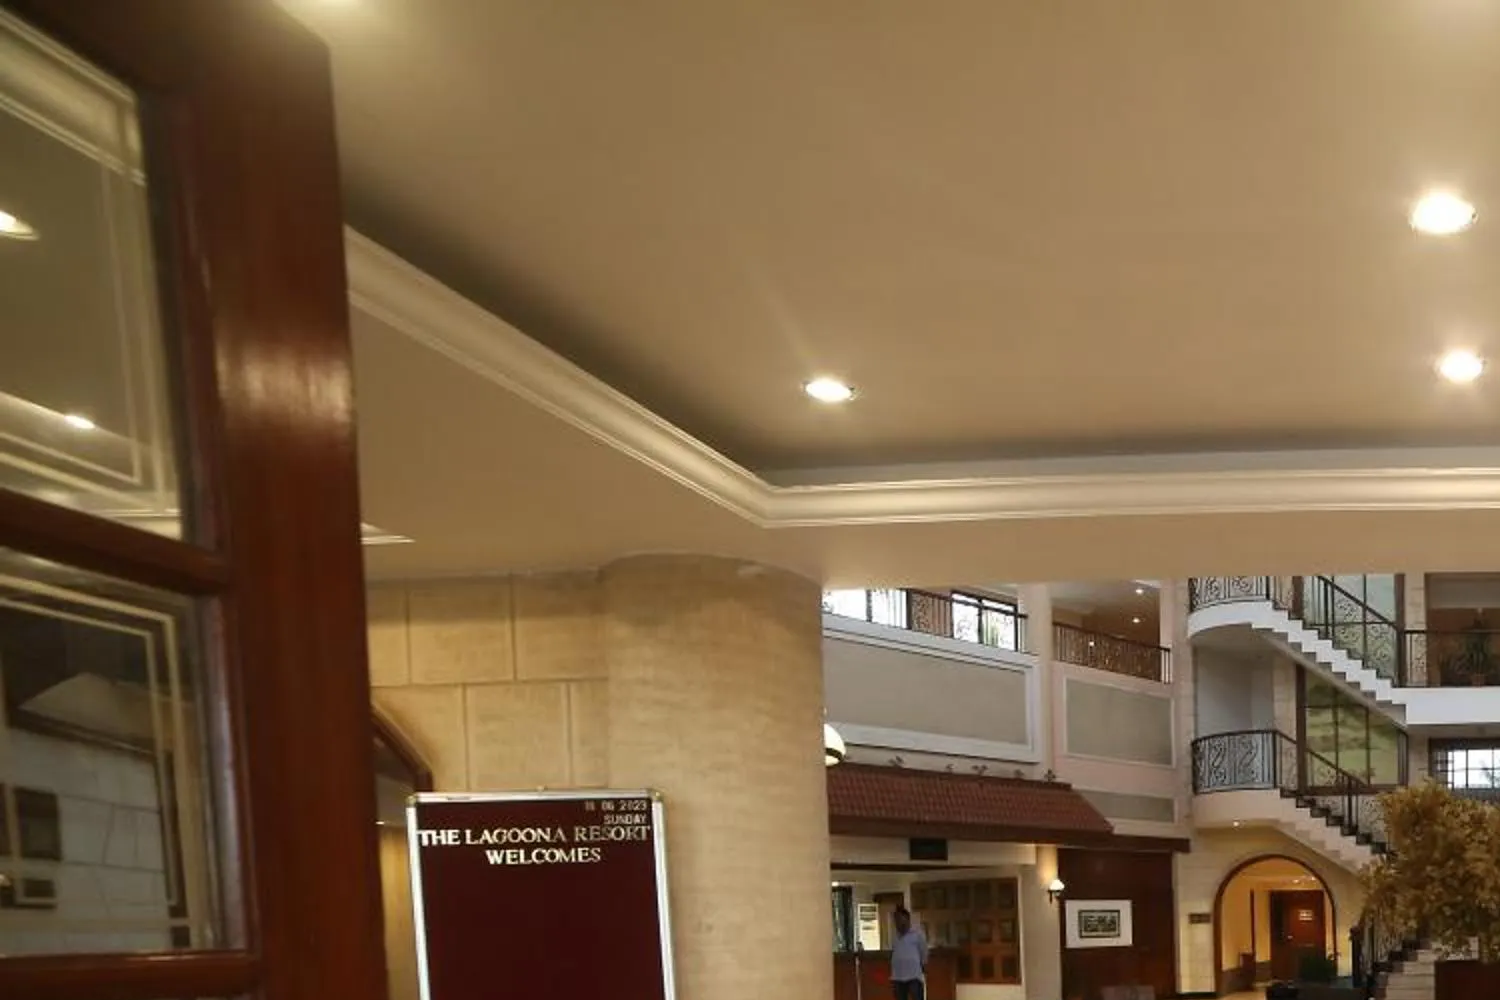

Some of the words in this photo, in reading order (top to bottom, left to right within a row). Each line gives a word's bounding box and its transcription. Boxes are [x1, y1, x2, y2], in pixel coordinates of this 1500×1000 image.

[603, 814, 647, 824] SUNDAY
[417, 829, 461, 846] THE
[464, 826, 567, 845] LAGOONA
[574, 825, 650, 841] RESORT
[486, 847, 601, 866] WELCOMES
